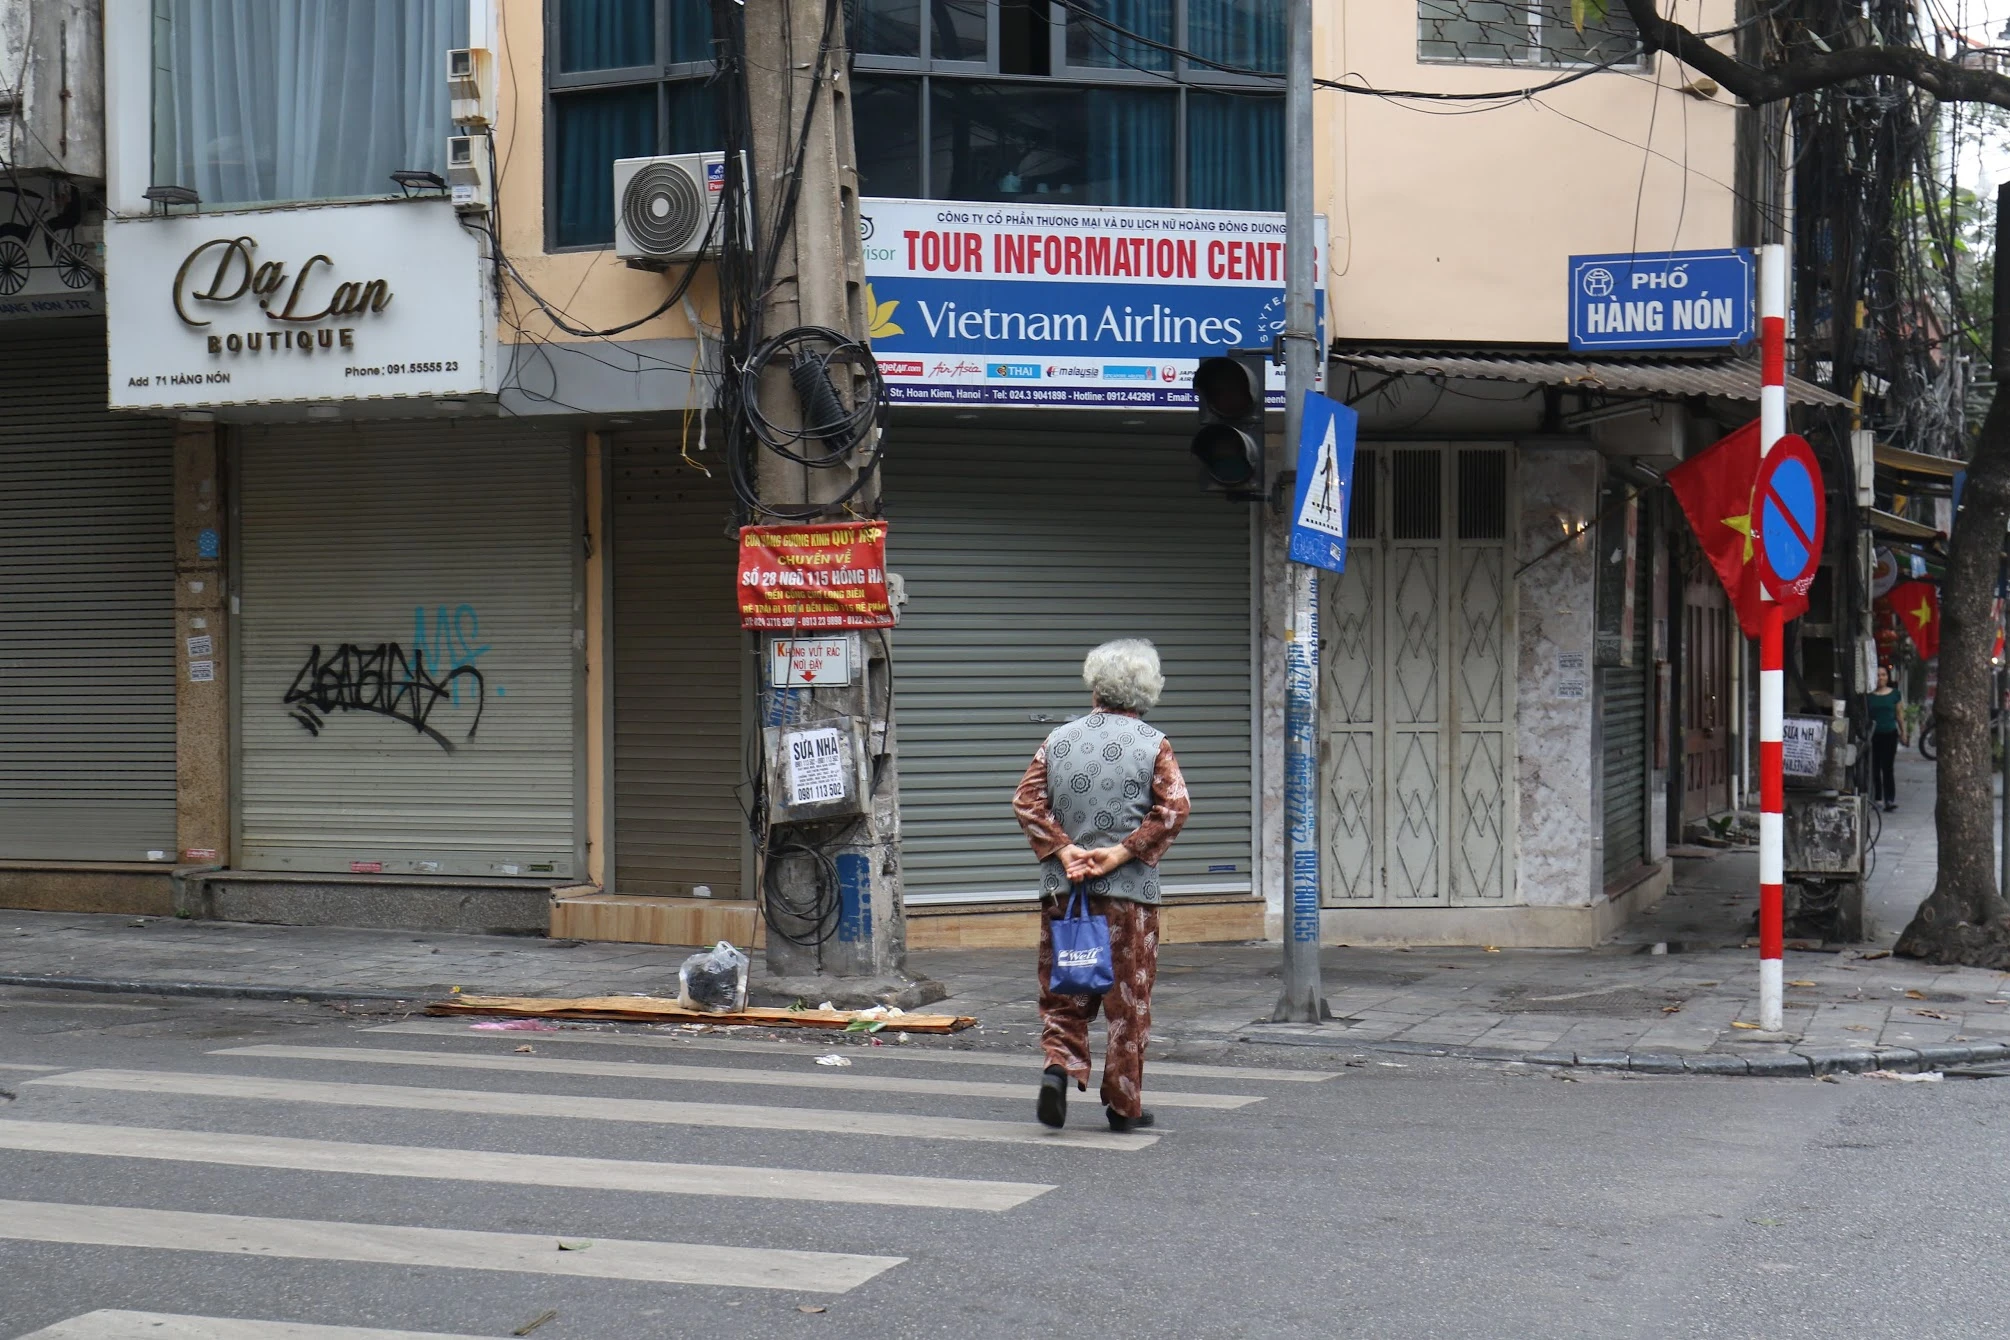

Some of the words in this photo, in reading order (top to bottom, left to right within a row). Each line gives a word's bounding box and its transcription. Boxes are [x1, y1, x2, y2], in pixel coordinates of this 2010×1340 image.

[937, 210, 969, 223] CÔNG
[972, 214, 983, 224] TY
[986, 209, 1003, 224] CỔ
[1006, 211, 1033, 225] PHẦN
[1037, 216, 1079, 226] THƯƠNG
[1082, 217, 1100, 229] MẠI
[1104, 216, 1118, 228] VÀ
[1121, 219, 1134, 228] DU
[1137, 219, 1159, 231] LỊCH
[1162, 218, 1177, 229] NỮ
[1179, 218, 1215, 230] HOÀNG
[1219, 219, 1248, 231] ĐÔNG
[1251, 222, 1286, 233] DƯƠNG
[863, 244, 896, 261] isor
[903, 230, 983, 273] TOUR
[994, 233, 1197, 279] INFORMATION
[1208, 240, 1318, 282] CENT
[172, 236, 289, 327] Dạ
[266, 254, 394, 322] Lan
[1631, 264, 1689, 290] PHỐ
[1587, 295, 1664, 334] HÀNG
[1672, 291, 1733, 331] NÓN
[917, 300, 1088, 341] Vietnam
[1094, 304, 1242, 346] Airlines
[207, 328, 355, 354] BOUTIQUE
[387, 362, 442, 374] 091.55555
[445, 361, 458, 371] 23
[1008, 366, 1033, 376] THAI
[1059, 366, 1099, 378] malaysia
[128, 376, 149, 387] Add
[156, 376, 167, 386] 71
[170, 372, 202, 385] HÀNG
[206, 370, 230, 384] NÓN
[890, 387, 904, 398] Str,
[906, 388, 928, 398] Hoan
[930, 388, 954, 399] Kiem,
[957, 389, 981, 398] Hanoi
[993, 390, 1007, 399] Tel:
[1009, 390, 1032, 399] 024.3
[1033, 391, 1066, 400] 9041898
[1074, 391, 1105, 401] Hotline:
[1106, 392, 1155, 401] 0912.442991
[1167, 392, 1192, 402] Email:
[777, 550, 830, 565] CHUYỂN
[835, 548, 851, 563] VỀ
[742, 566, 760, 586] SỐ
[762, 571, 777, 586] 28
[779, 568, 804, 586] NGÕ
[807, 570, 828, 586] 115
[831, 564, 865, 585] HỒNG
[867, 566, 884, 583] HÀ
[1801, 727, 1815, 741] NH
[793, 733, 814, 761] SỬA
[816, 733, 838, 757] NHÀ
[816, 784, 828, 799] 113
[829, 782, 842, 796] 502
